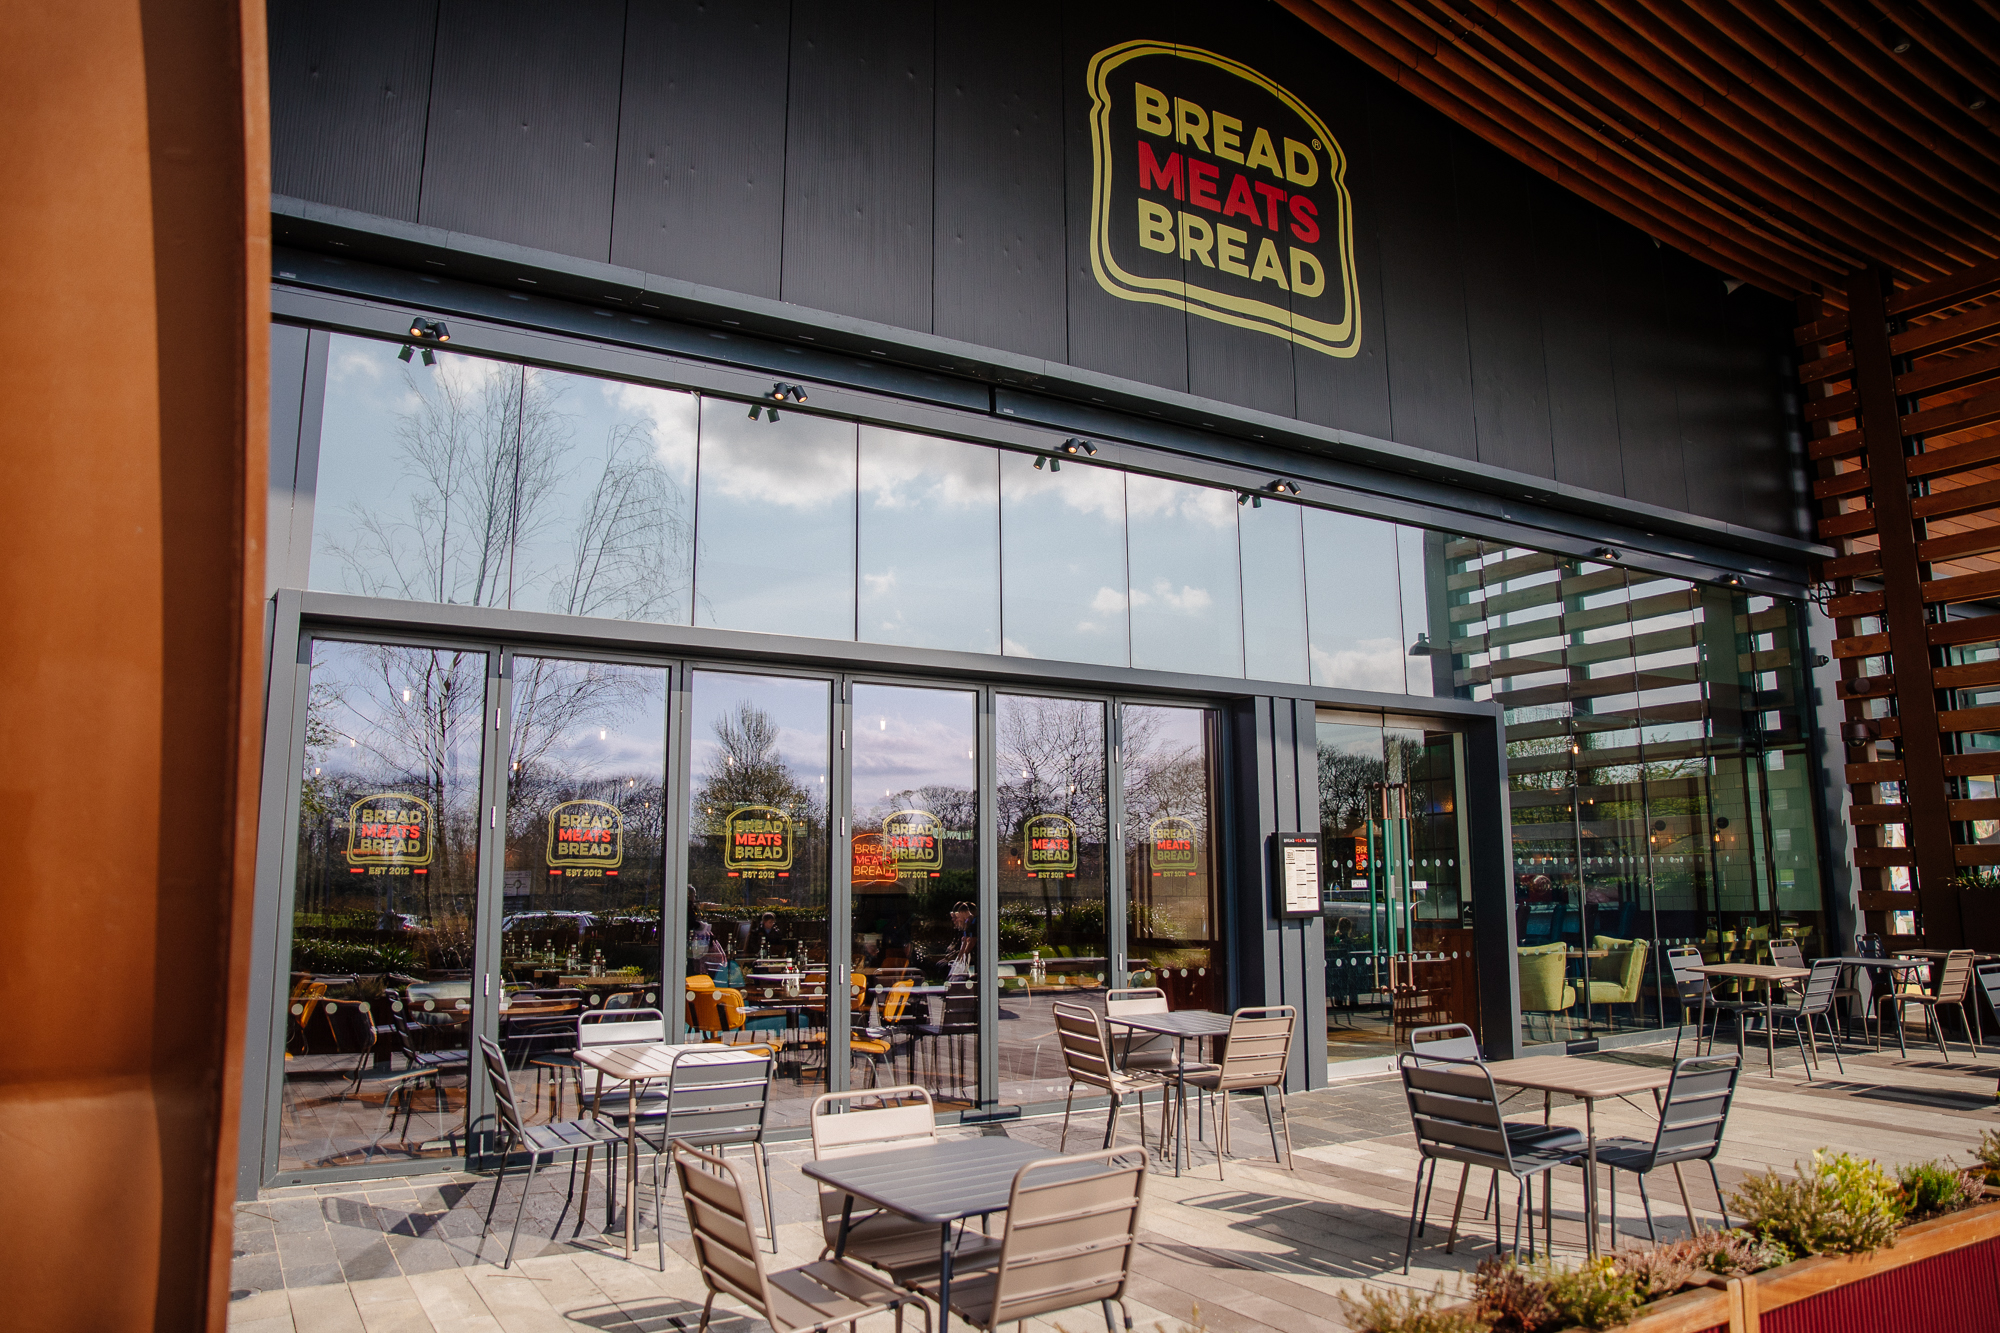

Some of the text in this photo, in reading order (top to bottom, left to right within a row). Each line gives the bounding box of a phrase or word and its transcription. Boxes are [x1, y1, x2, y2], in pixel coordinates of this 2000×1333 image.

[1135, 82, 1319, 187] BREAD
[1138, 140, 1320, 244] MEATS
[1138, 198, 1325, 297] BREAD
[362, 809, 422, 824] BREAD
[559, 814, 613, 828] BREAD
[361, 824, 420, 839] MEATS
[735, 820, 783, 833] BREAD
[891, 823, 933, 835] BREAD
[1032, 827, 1070, 838] BREAD
[559, 829, 611, 842] MEATS
[735, 833, 782, 846] MEATS
[1156, 829, 1191, 839] BREAD
[360, 839, 421, 853] BREAD
[891, 836, 934, 848] MEATS
[1032, 839, 1069, 850] MEATS
[1157, 840, 1191, 850] MEATS
[558, 843, 612, 856] BREAD
[735, 847, 783, 859] BREAD
[854, 844, 892, 854] BREAD
[891, 848, 934, 860] BREAD
[855, 855, 891, 865] MEATS
[1032, 850, 1070, 861] BREAD
[1157, 851, 1191, 861] BREAD
[368, 867, 410, 875] EST 2012
[566, 869, 603, 877] EST 2012
